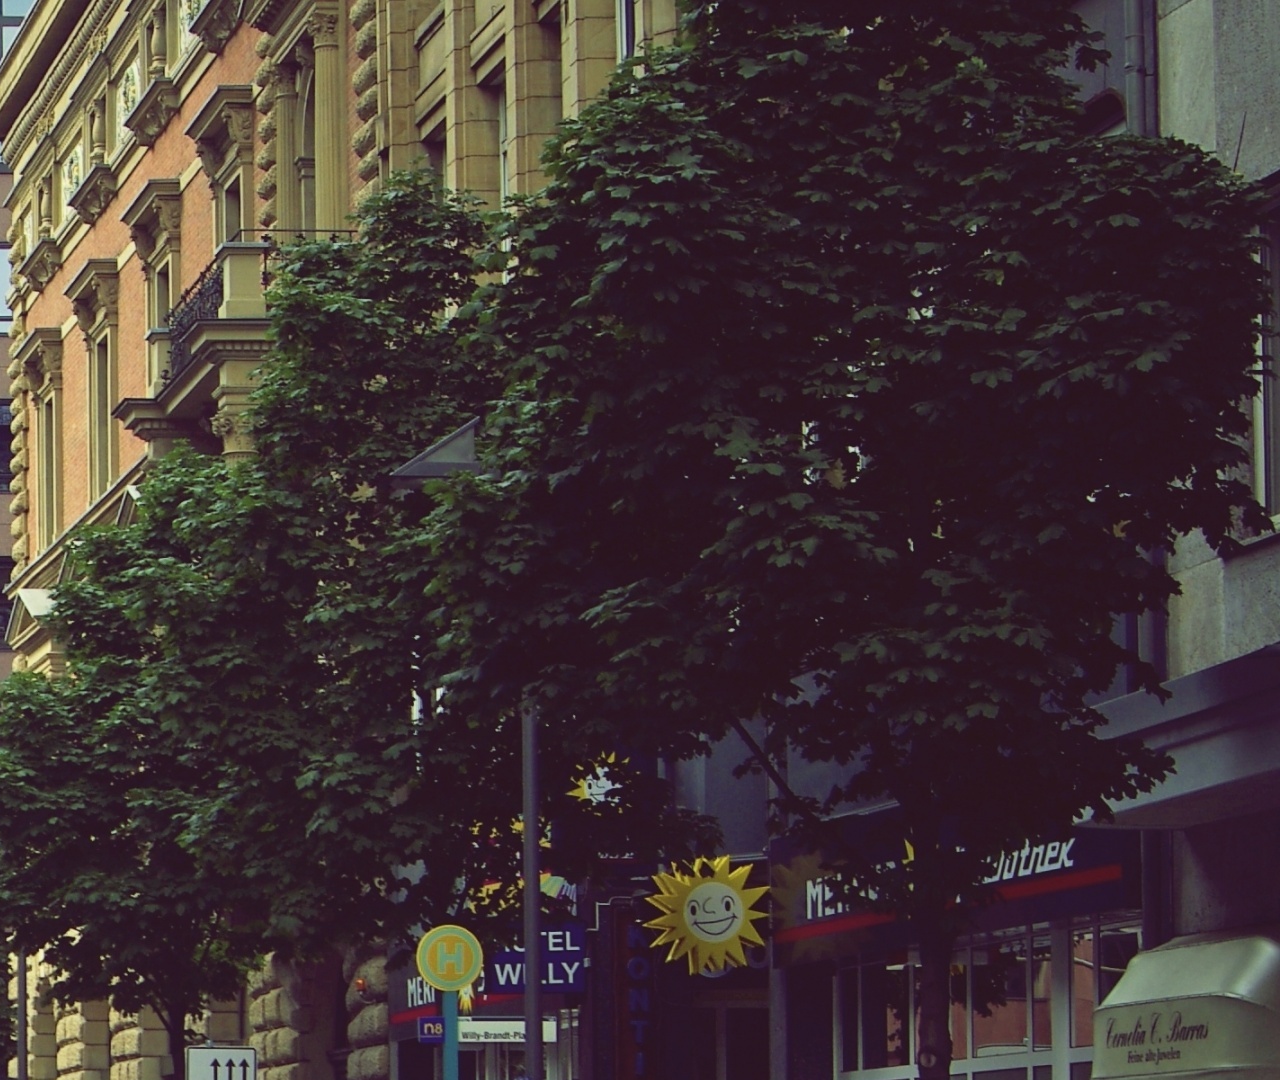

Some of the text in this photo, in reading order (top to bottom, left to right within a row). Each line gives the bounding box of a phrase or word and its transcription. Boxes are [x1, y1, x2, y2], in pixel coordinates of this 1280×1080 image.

[438, 942, 465, 975] H
[424, 1023, 443, 1035] n8
[462, 1030, 526, 1041] Willy-Brandt-Pla
[1106, 1017, 1146, 1048] Cornelia
